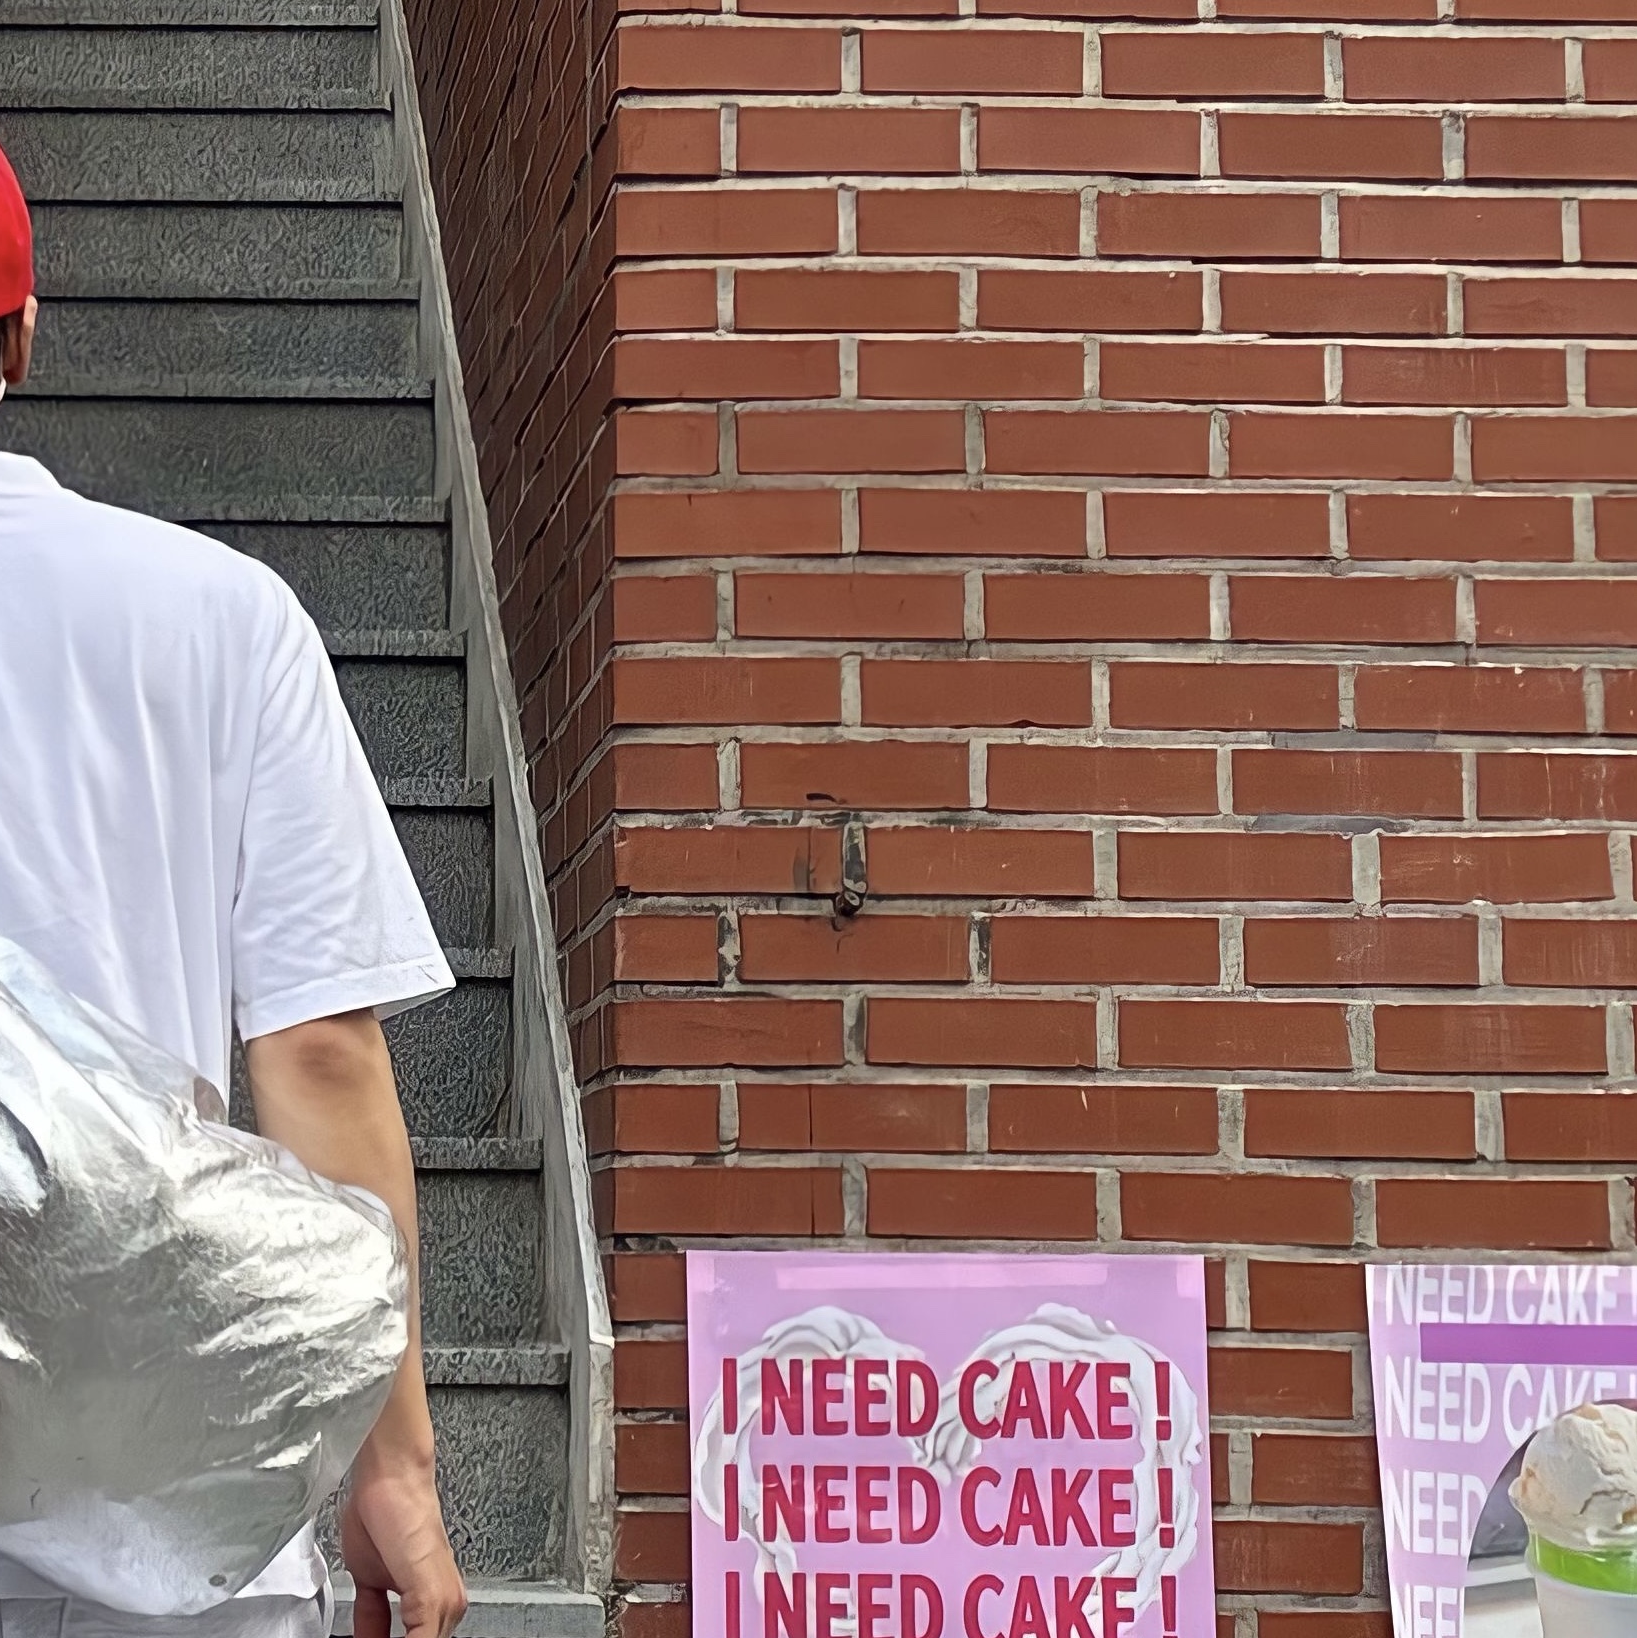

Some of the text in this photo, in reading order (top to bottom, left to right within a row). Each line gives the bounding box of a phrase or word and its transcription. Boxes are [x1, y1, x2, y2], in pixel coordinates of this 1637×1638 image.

[1385, 1265, 1495, 1325] NEED
[723, 1358, 737, 1434] I
[762, 1358, 939, 1436] NEED
[959, 1359, 1133, 1439] CAKE
[1384, 1354, 1492, 1444] NEED
[724, 1464, 739, 1541] I
[762, 1465, 941, 1544] NEED
[961, 1466, 1136, 1547] CAKE
